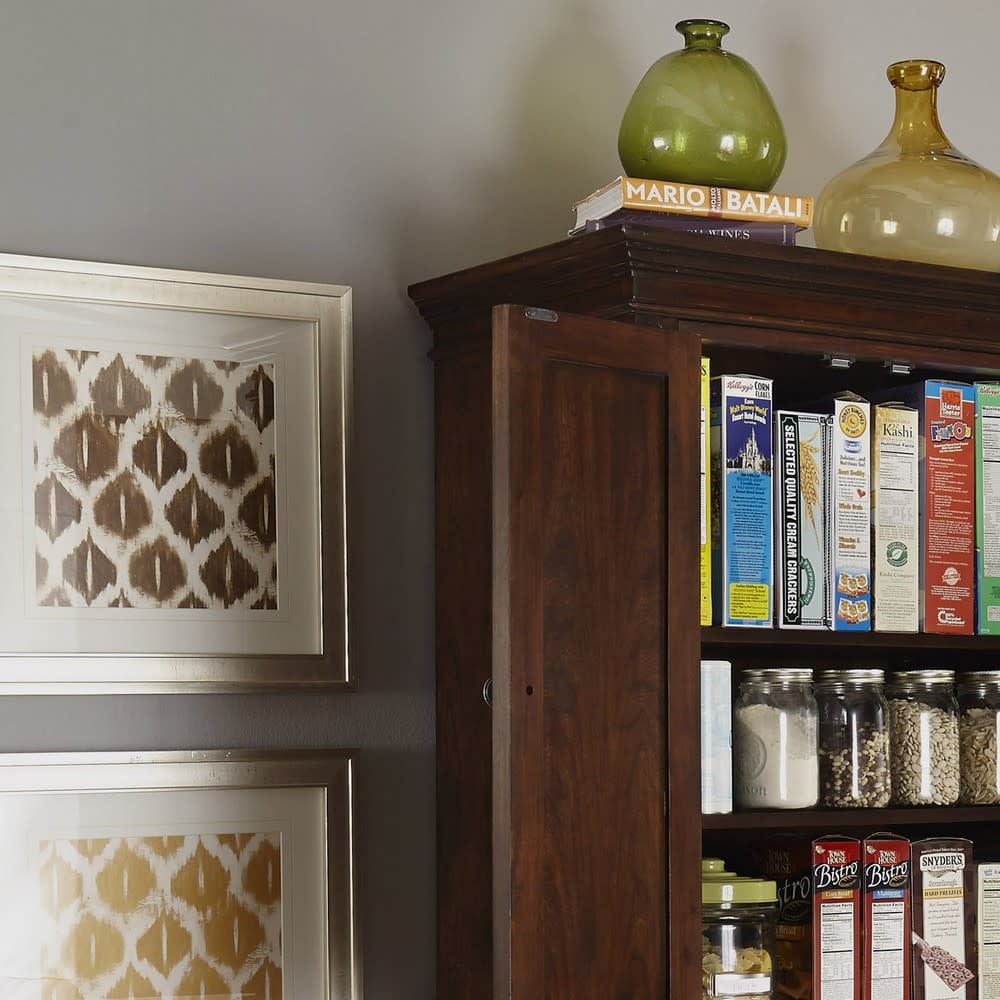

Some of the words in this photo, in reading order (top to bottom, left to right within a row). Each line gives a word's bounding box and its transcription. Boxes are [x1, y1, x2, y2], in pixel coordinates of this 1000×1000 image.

[626, 182, 705, 207] MARIO
[727, 190, 802, 217] BATALI
[708, 229, 750, 240] WINES
[728, 380, 753, 392] Kellogg's
[980, 386, 1000, 396] Kellogg's
[942, 403, 961, 411] Harris
[883, 424, 913, 438] Kashi
[784, 424, 796, 475] SELECTED
[785, 477, 797, 520] QUALITY
[786, 522, 797, 558] CREAM
[787, 560, 798, 614] CRACKERS
[922, 854, 963, 867] SNYDER'S
[815, 861, 858, 888] Bistro
[865, 861, 908, 888] Bistro
